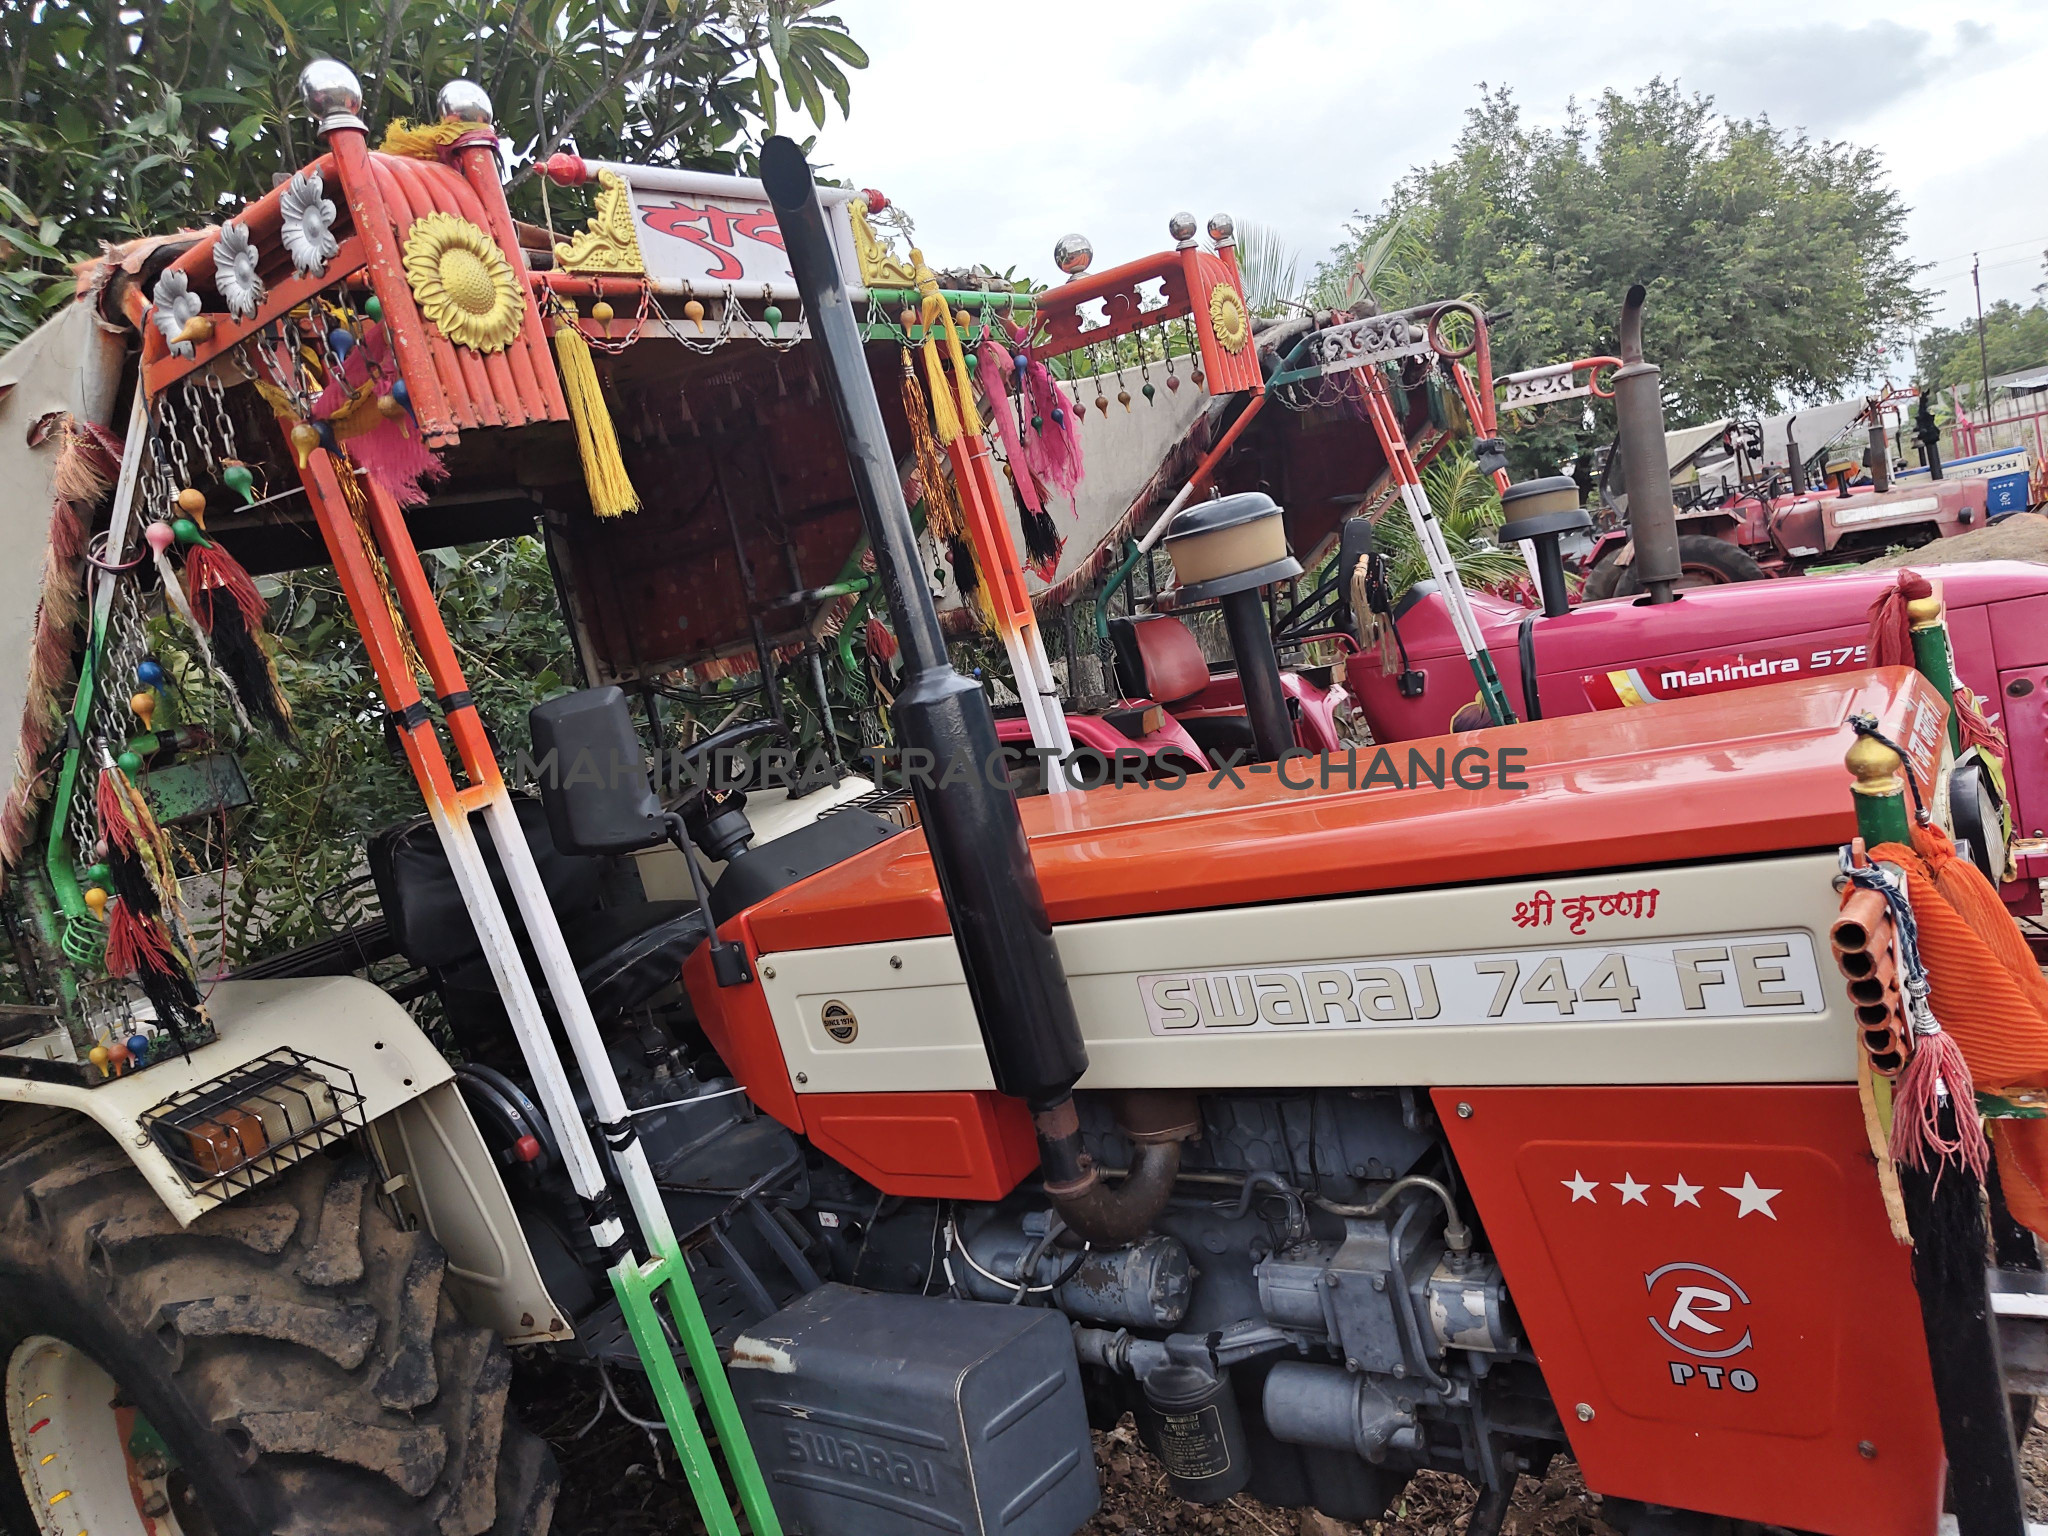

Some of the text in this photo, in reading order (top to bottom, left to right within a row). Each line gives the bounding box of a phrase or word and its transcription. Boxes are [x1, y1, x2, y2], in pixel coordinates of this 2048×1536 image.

[1660, 656, 1800, 689] Mahindra
[1511, 888, 1661, 935] श्री कृष्णा
[1474, 953, 1641, 1018] 744
[1672, 942, 1805, 1010] FE
[1668, 1361, 1759, 1393] PTO
